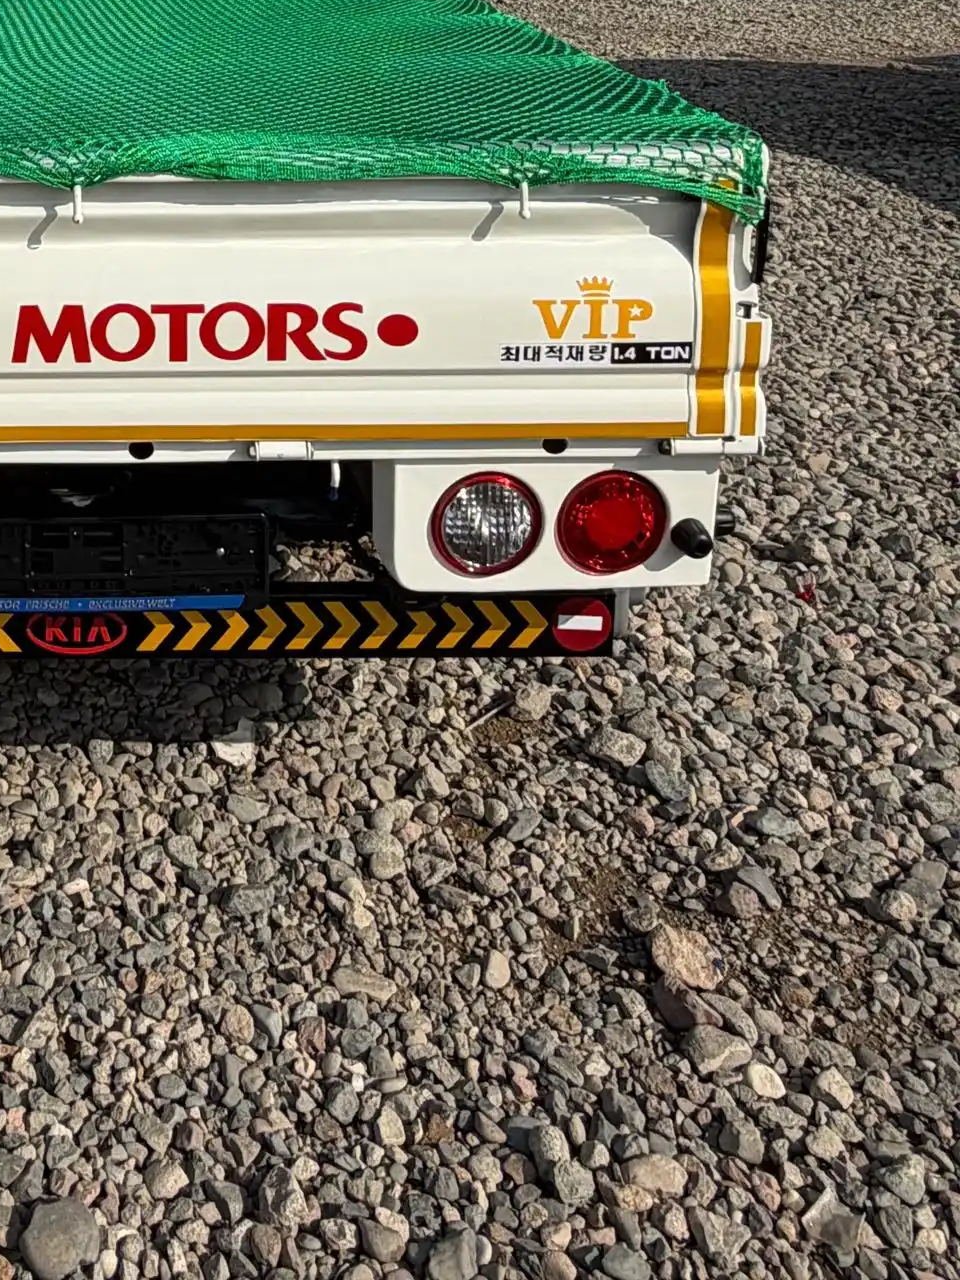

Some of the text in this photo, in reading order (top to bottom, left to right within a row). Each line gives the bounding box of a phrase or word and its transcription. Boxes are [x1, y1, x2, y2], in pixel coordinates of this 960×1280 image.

[11, 302, 368, 364] MOTORS
[532, 299, 654, 339] VIP
[500, 345, 608, 362] 최대적재량
[613, 345, 690, 360] 1.4 TON
[45, 614, 112, 643] KIA
